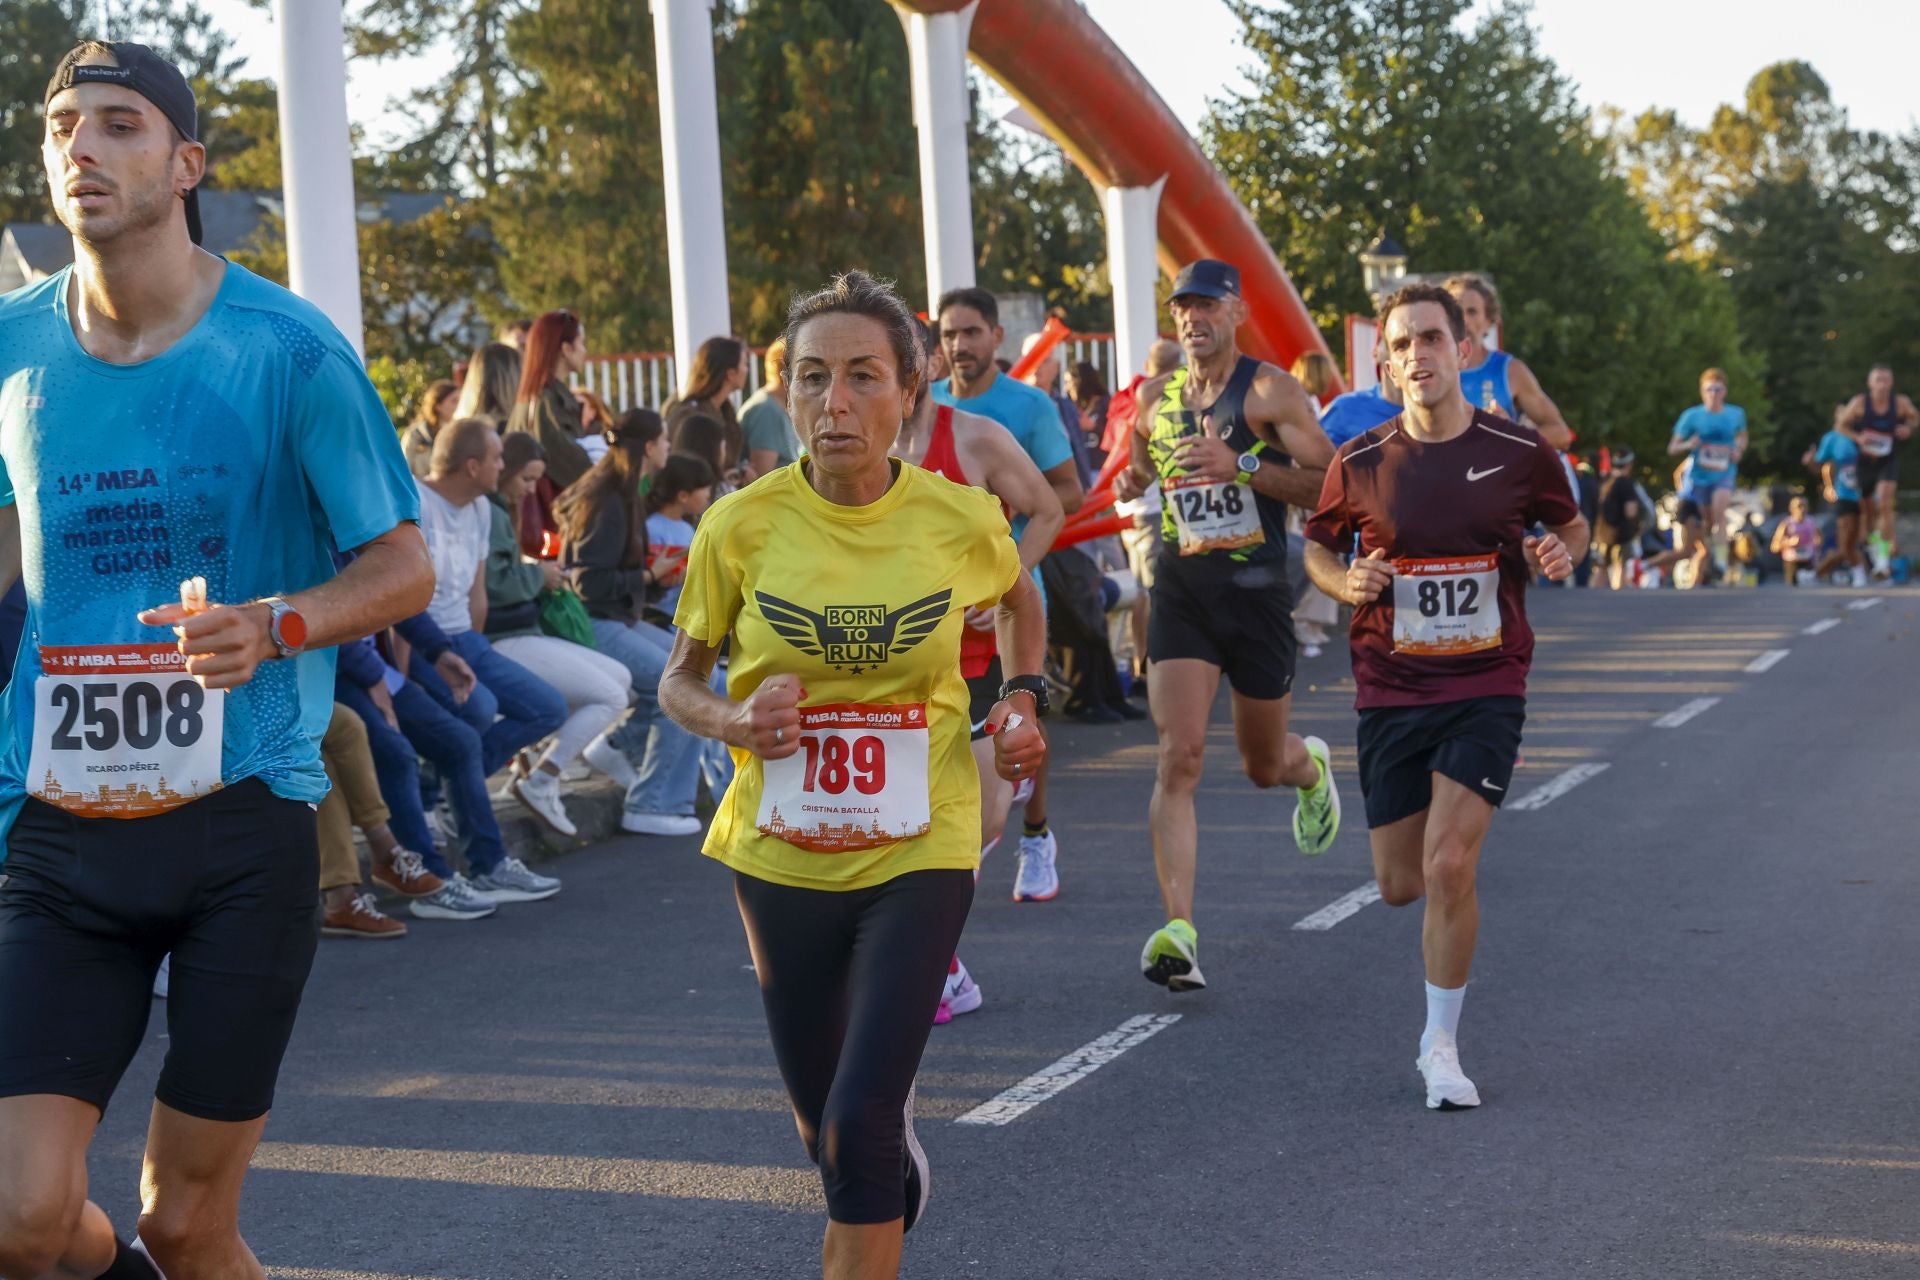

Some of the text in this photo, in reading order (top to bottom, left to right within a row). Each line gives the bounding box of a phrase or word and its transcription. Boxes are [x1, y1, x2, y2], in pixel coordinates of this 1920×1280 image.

[57, 472, 92, 496] 14ª
[96, 468, 160, 492] MBA
[86, 498, 164, 525] media
[1173, 484, 1243, 523] 1248
[63, 522, 169, 550] maratón
[91, 546, 172, 576] GIJÓN
[1418, 578, 1479, 618] 812
[829, 608, 882, 626] BORN
[843, 628, 869, 642] TO
[78, 654, 117, 667] MBA
[830, 644, 884, 661] RUN
[51, 679, 204, 752] 2508
[806, 711, 839, 724] MBA
[866, 711, 902, 723] GIJÓN
[86, 761, 160, 773] RICARDO PÉREZ
[800, 734, 886, 795] 789
[801, 804, 880, 814] CRISTINA BATALLA
